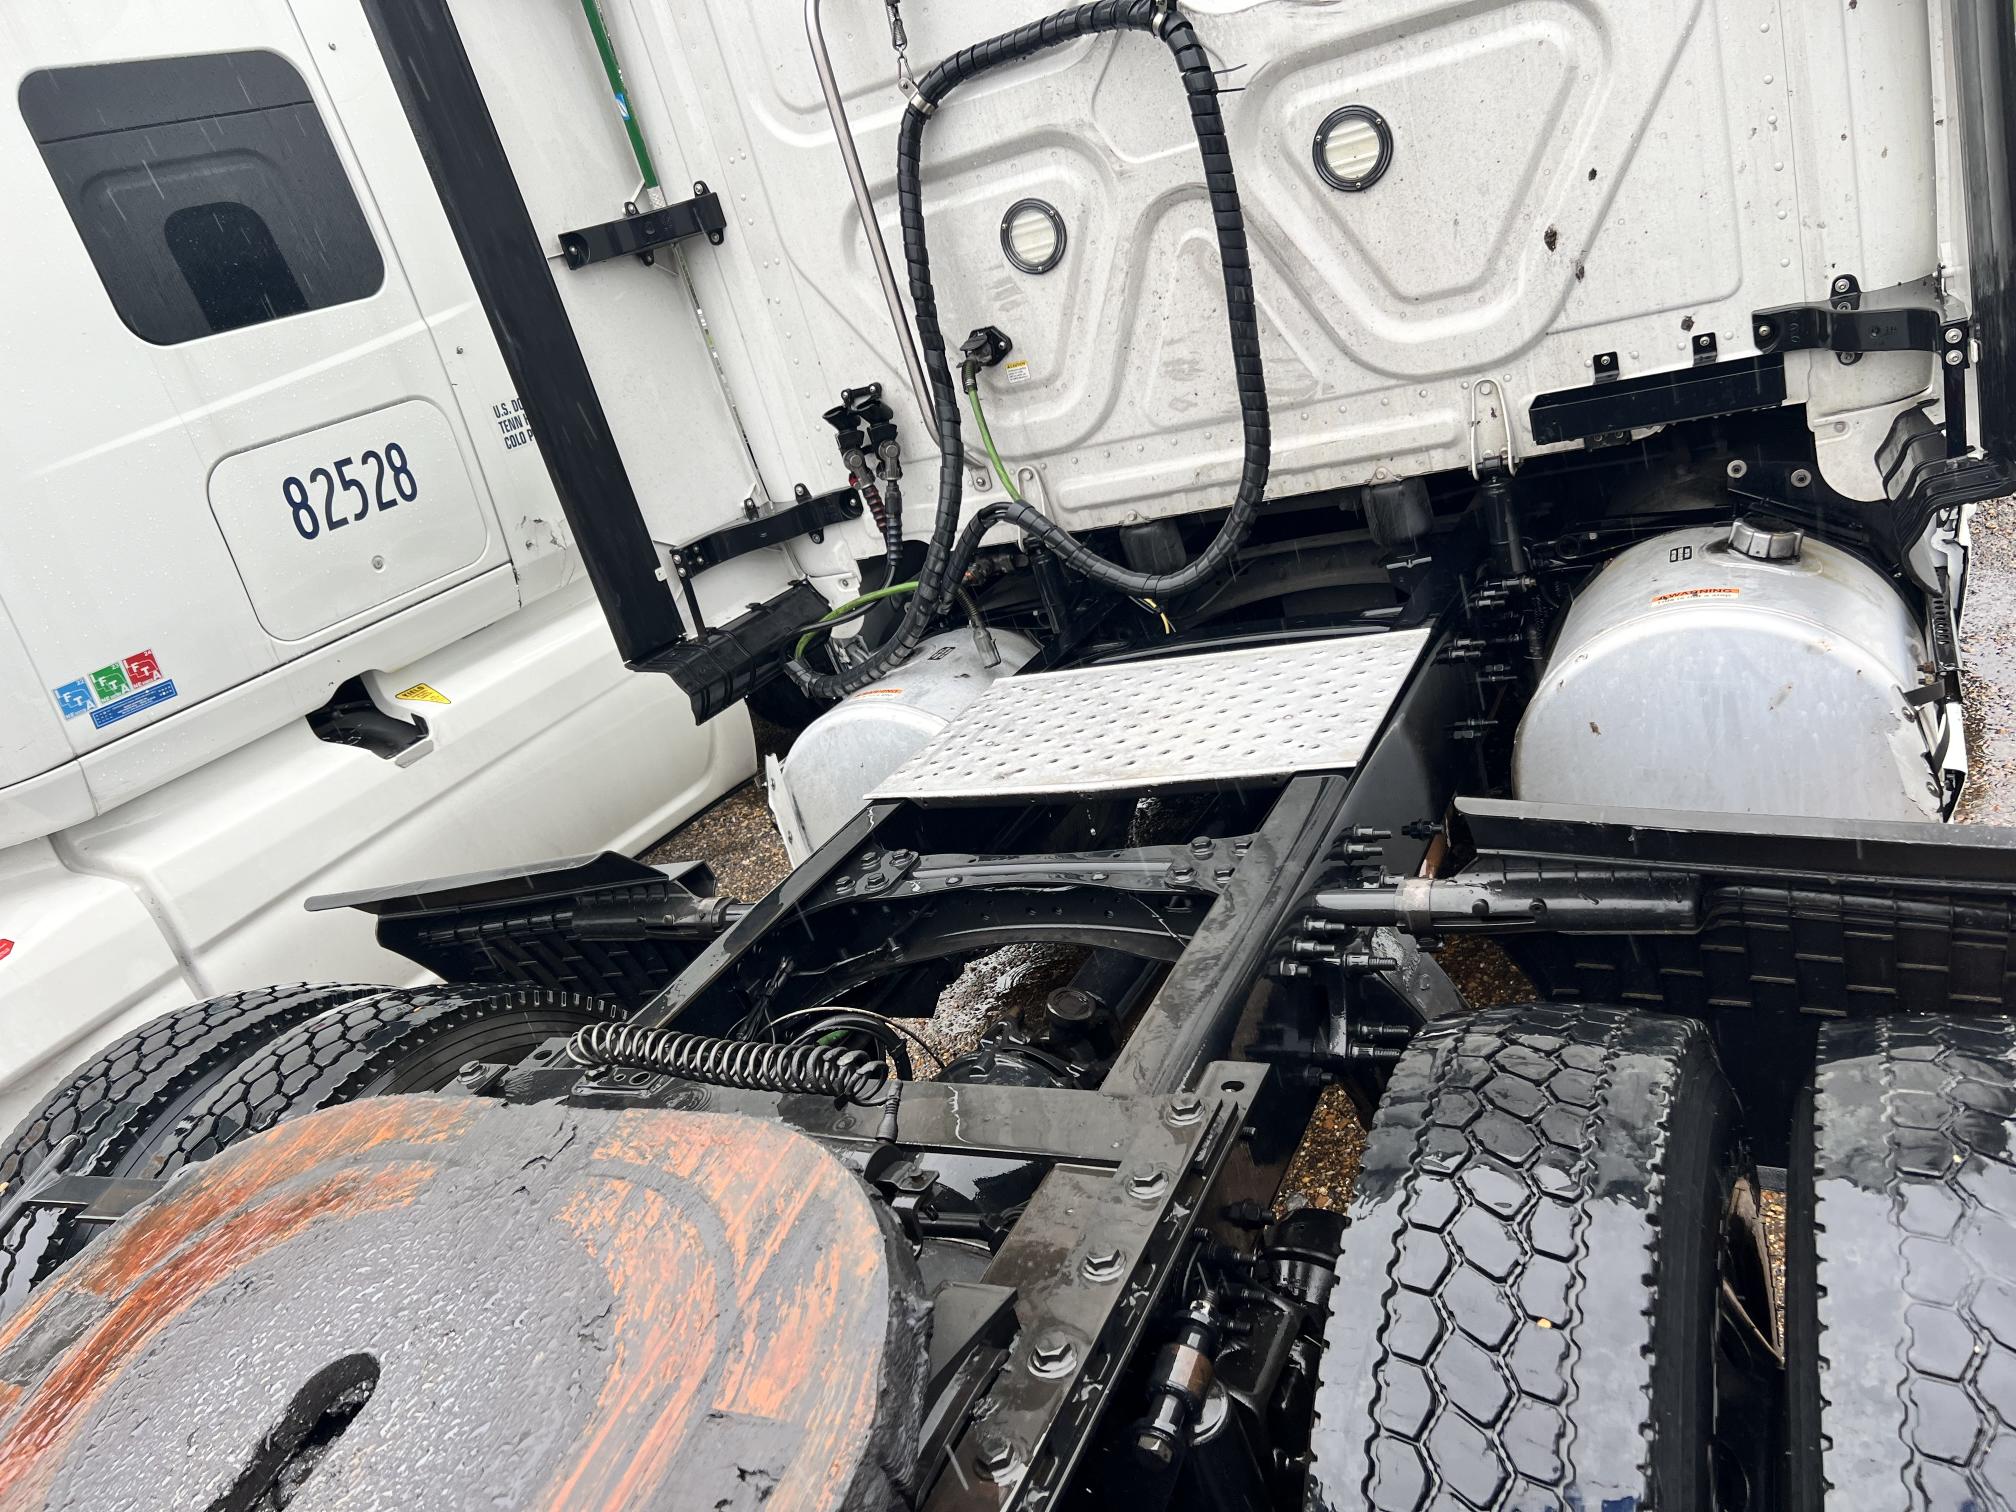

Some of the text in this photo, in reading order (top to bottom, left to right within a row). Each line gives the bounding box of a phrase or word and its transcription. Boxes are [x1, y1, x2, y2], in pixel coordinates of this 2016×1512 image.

[493, 402, 511, 418] U.S.
[498, 415, 523, 434] TENN
[282, 442, 418, 540] 82528
